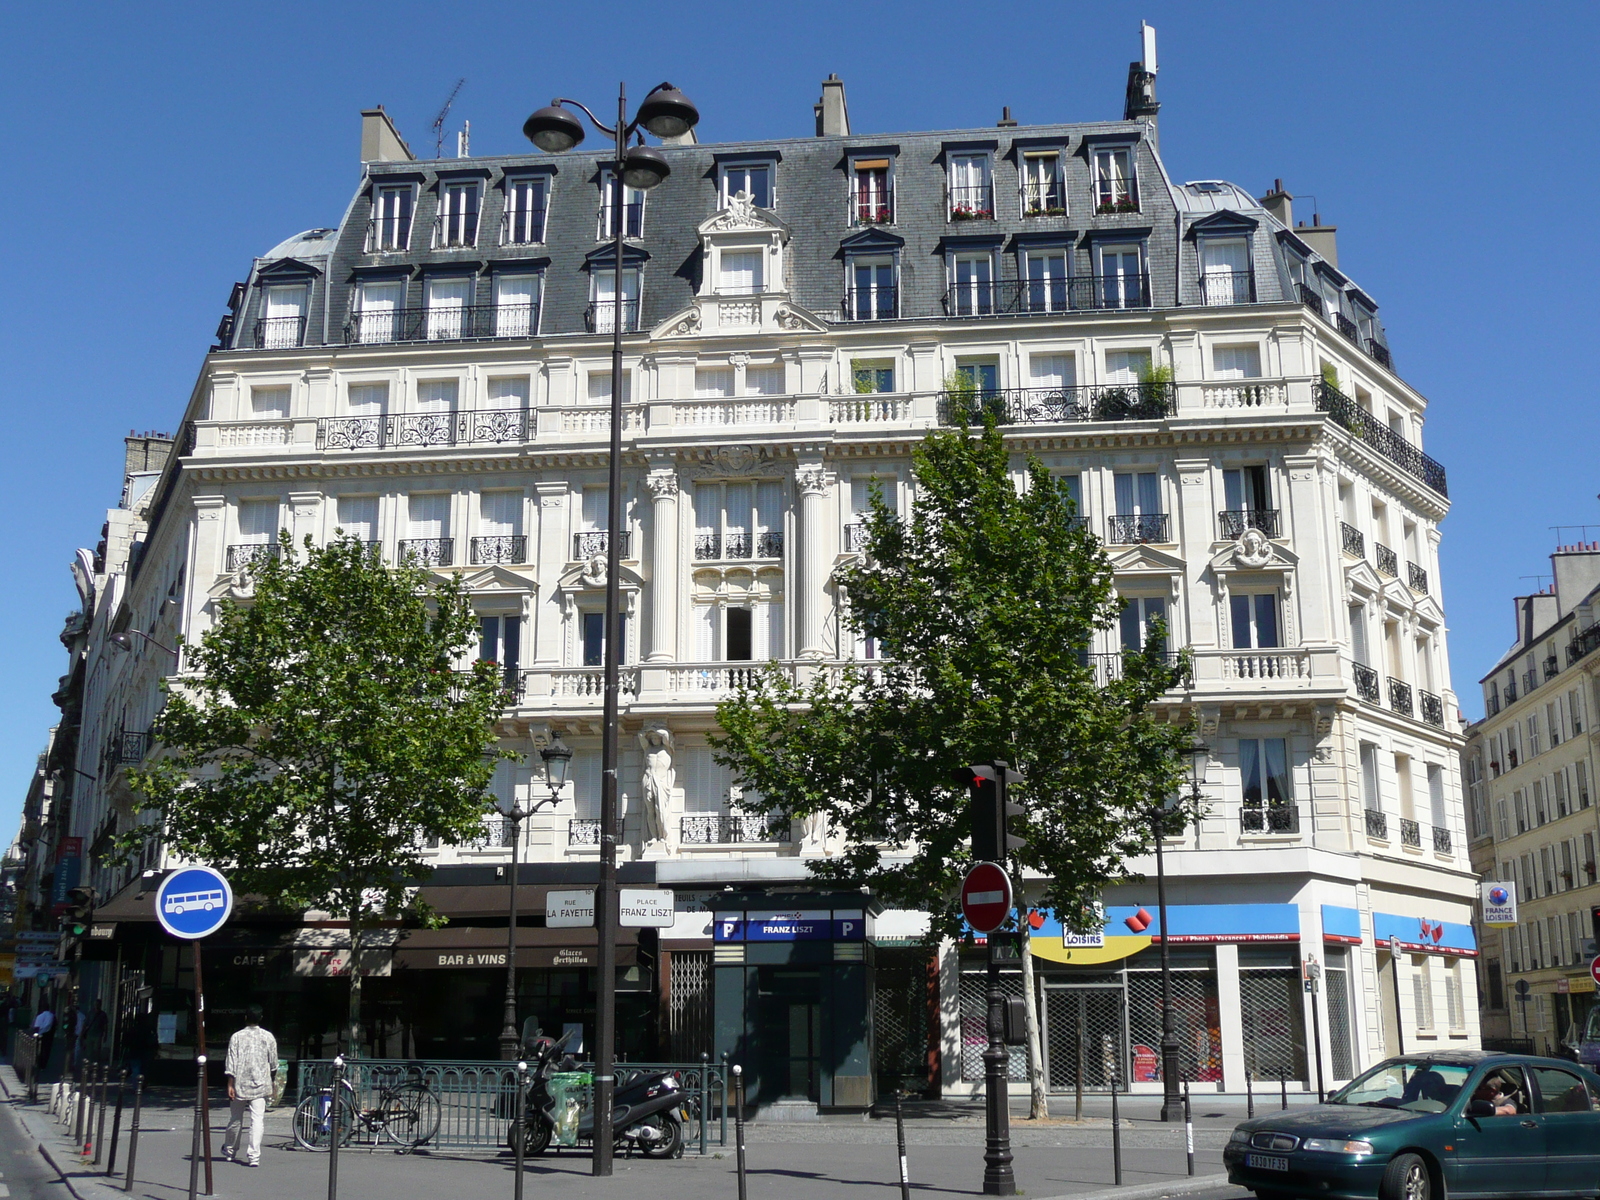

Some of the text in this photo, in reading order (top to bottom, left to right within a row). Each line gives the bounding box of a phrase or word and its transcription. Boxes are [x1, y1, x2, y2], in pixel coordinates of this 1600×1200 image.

[636, 898, 658, 906] PLACE
[675, 894, 696, 902] TEUILS
[547, 908, 594, 918] LA FAYETTE
[620, 908, 673, 917] FRANZ LISZT
[1485, 914, 1513, 922] LOISIRS
[723, 923, 735, 938] P
[763, 925, 814, 934] FRANZ LISZT
[842, 921, 854, 937] P
[1066, 936, 1101, 944] LOISIRS
[233, 955, 265, 966] CAFÉ
[438, 953, 507, 965] BAR à VINS
